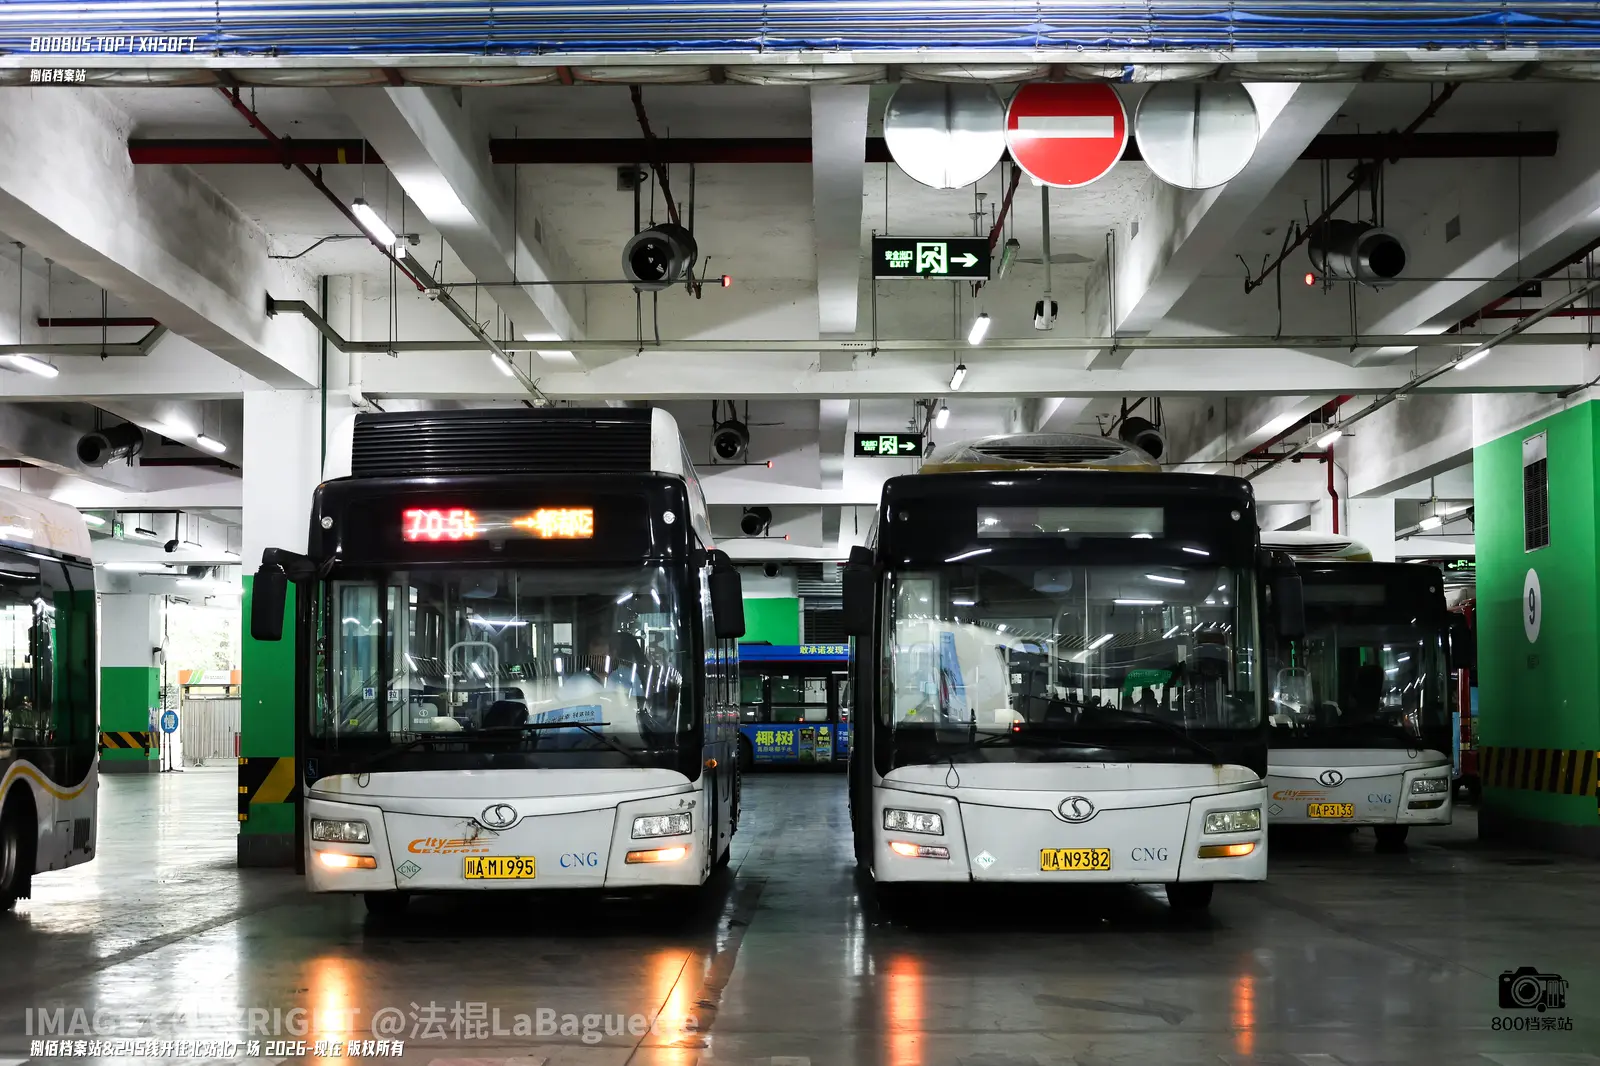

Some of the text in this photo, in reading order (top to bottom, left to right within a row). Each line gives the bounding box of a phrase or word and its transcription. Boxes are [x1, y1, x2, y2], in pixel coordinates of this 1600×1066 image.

[889, 260, 910, 268] EXIT
[1528, 587, 1536, 625] 9
[755, 730, 794, 746] 椰树
[1367, 792, 1392, 804] CNG
[560, 851, 598, 868] CNG
[1131, 847, 1169, 862] CNG
[400, 865, 417, 873] CNG
